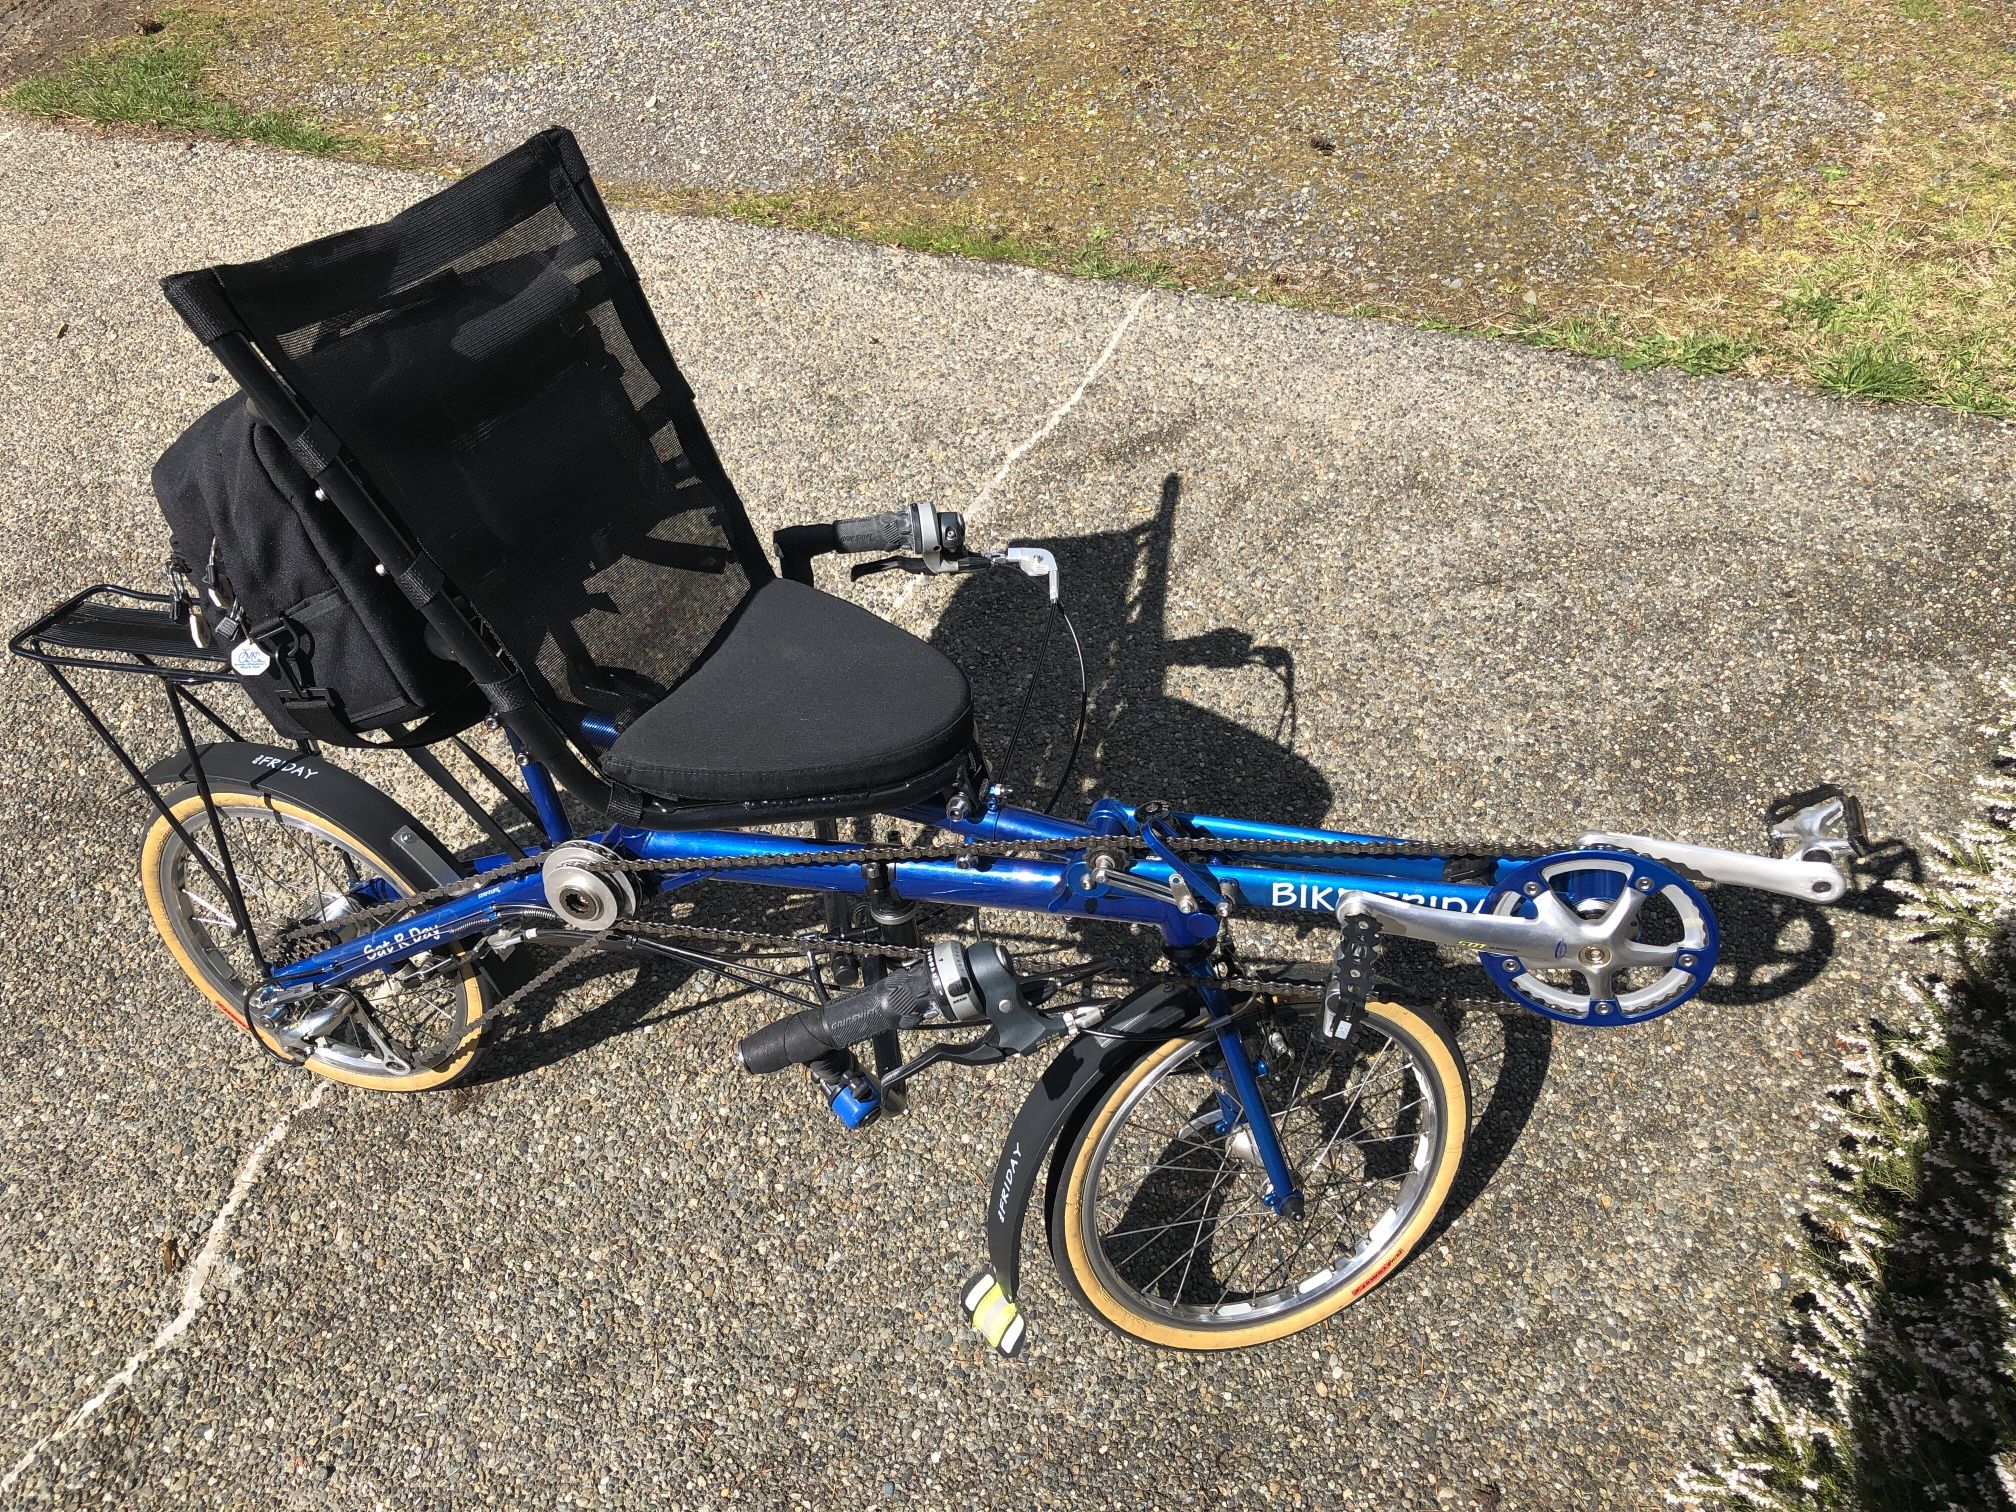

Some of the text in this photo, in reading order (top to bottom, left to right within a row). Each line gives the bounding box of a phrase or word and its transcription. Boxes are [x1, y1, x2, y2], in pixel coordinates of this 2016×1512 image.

[258, 756, 319, 779] FRIDAY
[1272, 881, 1486, 914] BIK RID
[363, 925, 441, 961] Sat R Day
[999, 1141, 1022, 1215] FRIDAY
